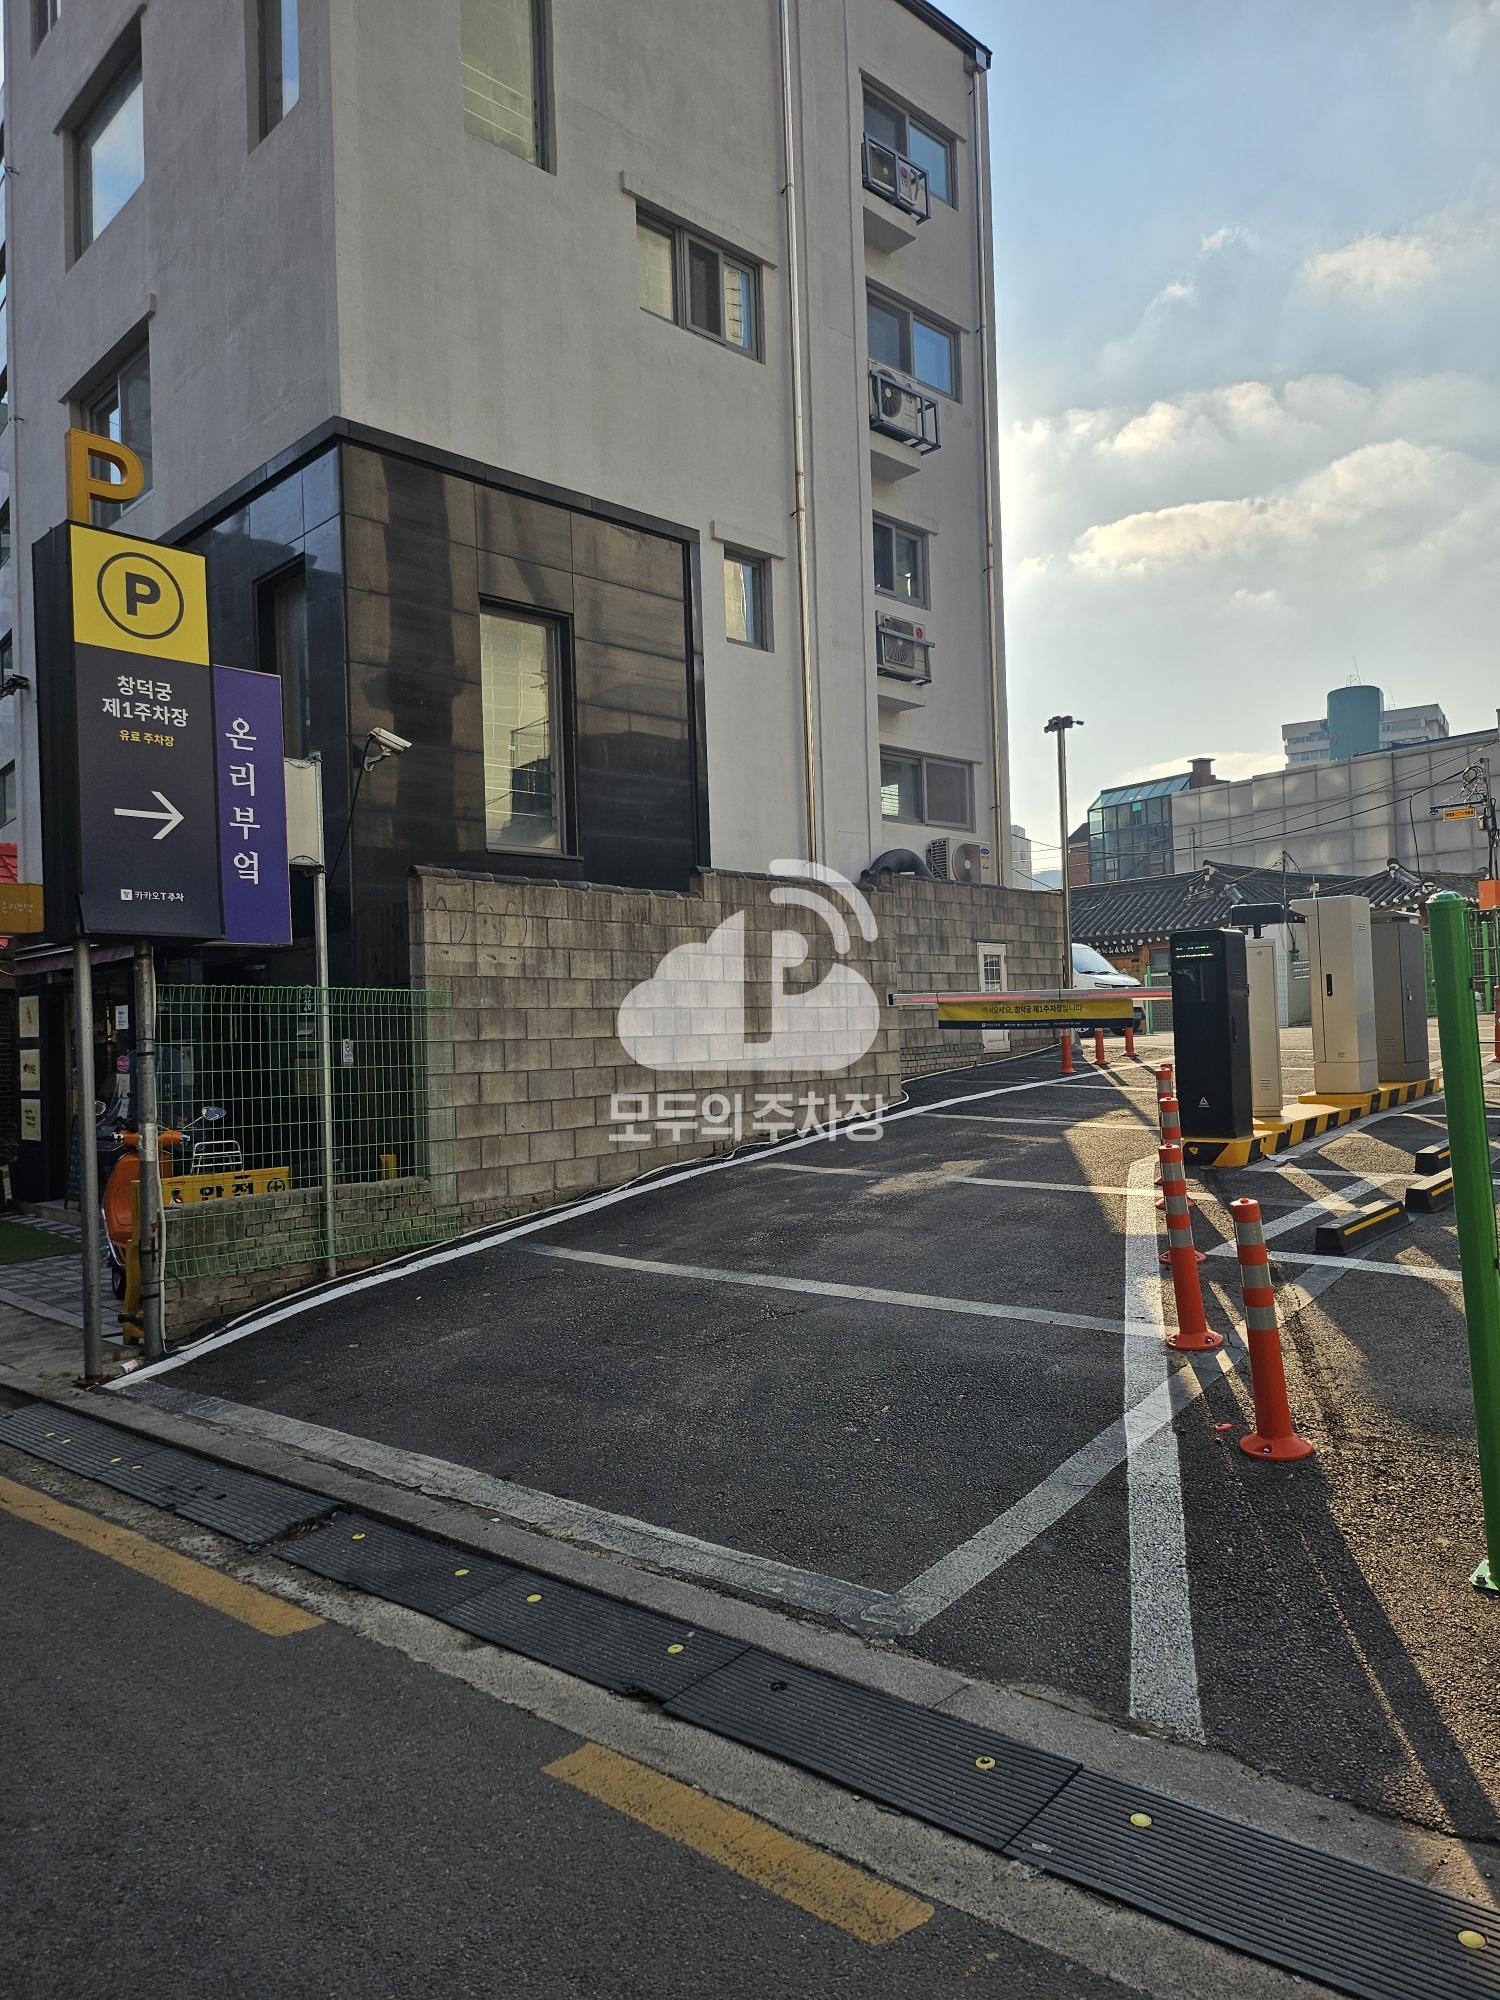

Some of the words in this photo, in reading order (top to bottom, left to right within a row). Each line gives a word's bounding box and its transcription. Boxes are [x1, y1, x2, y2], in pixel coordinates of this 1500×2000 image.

[65, 427, 144, 522] P
[125, 571, 161, 617] P
[117, 675, 173, 702] 창덕궁
[102, 698, 189, 727] 제1주차장
[119, 729, 141, 742] 유료
[143, 732, 175, 747] 주차장
